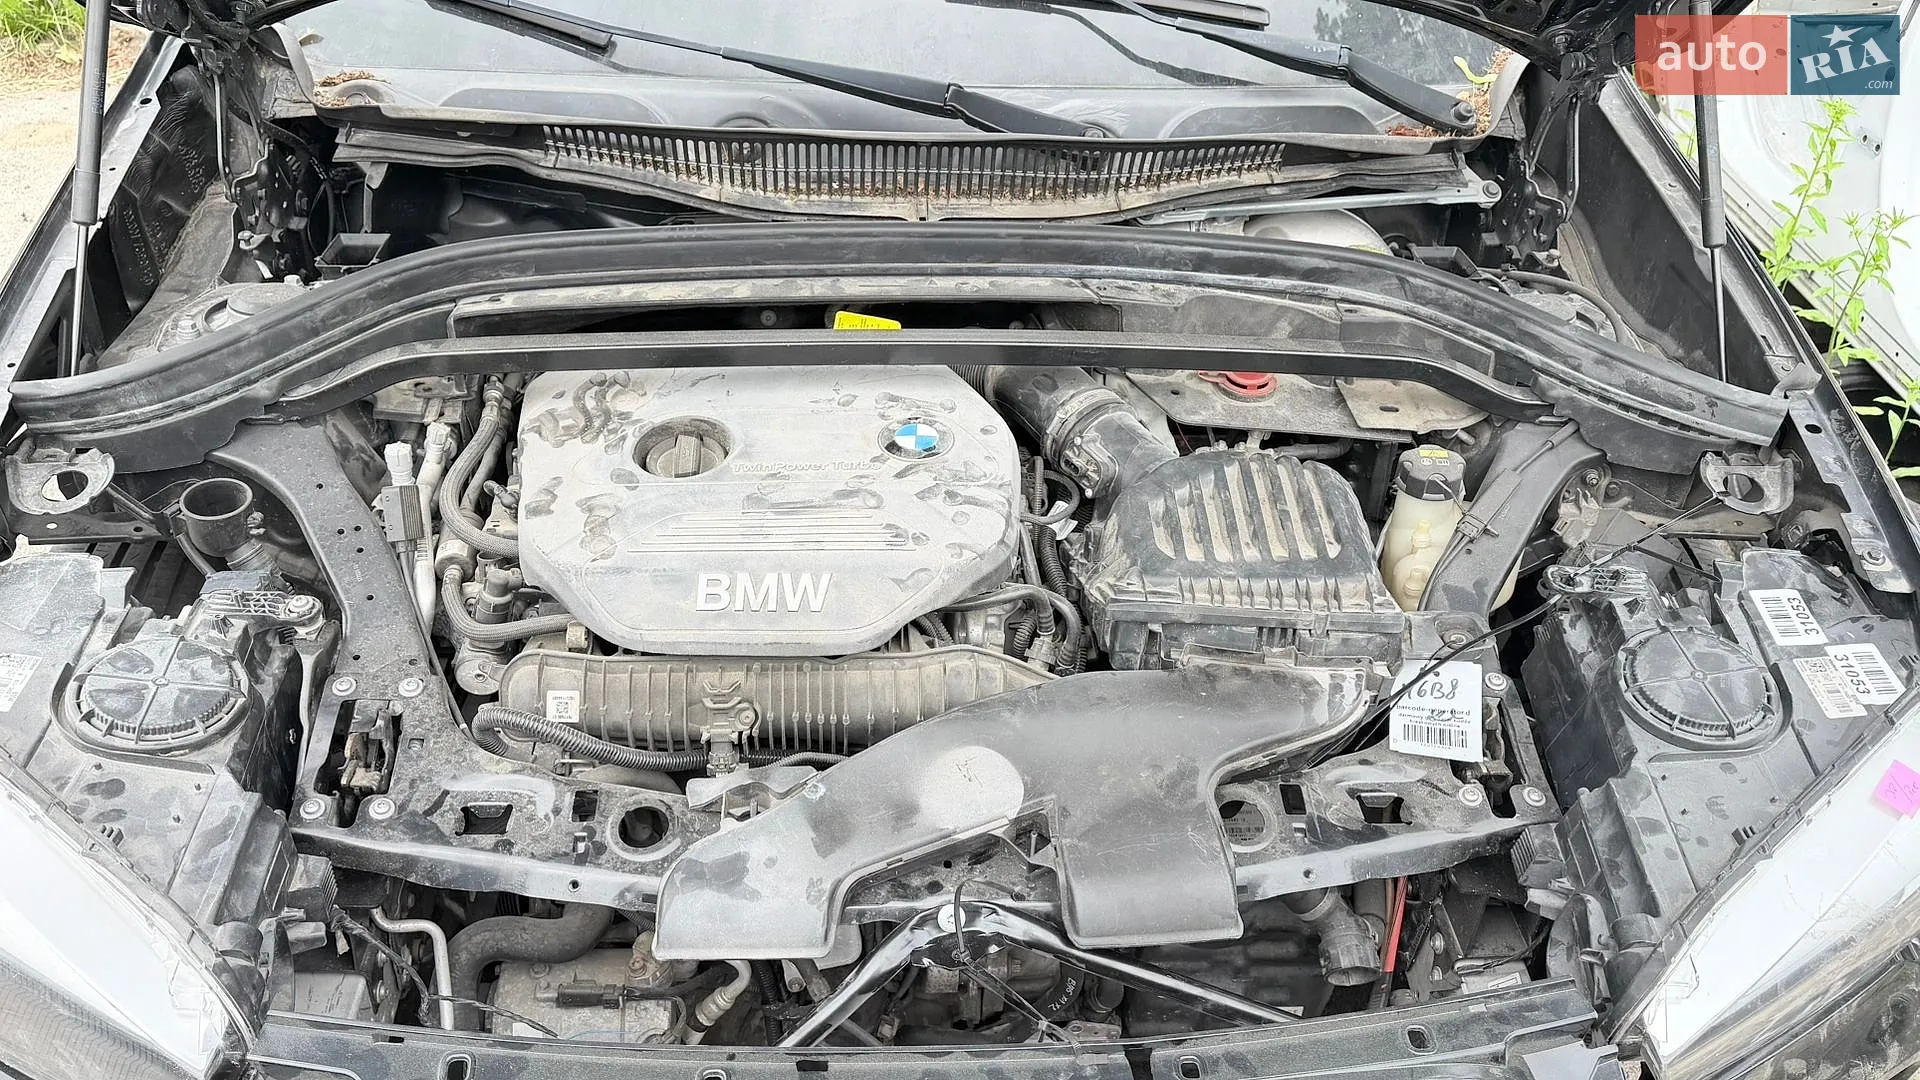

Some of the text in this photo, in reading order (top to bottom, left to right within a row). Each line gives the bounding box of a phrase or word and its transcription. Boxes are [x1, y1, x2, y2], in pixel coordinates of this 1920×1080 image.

[696, 572, 833, 612] BMW
[1787, 597, 1820, 635] 31053
[1834, 654, 1871, 695] 31053
